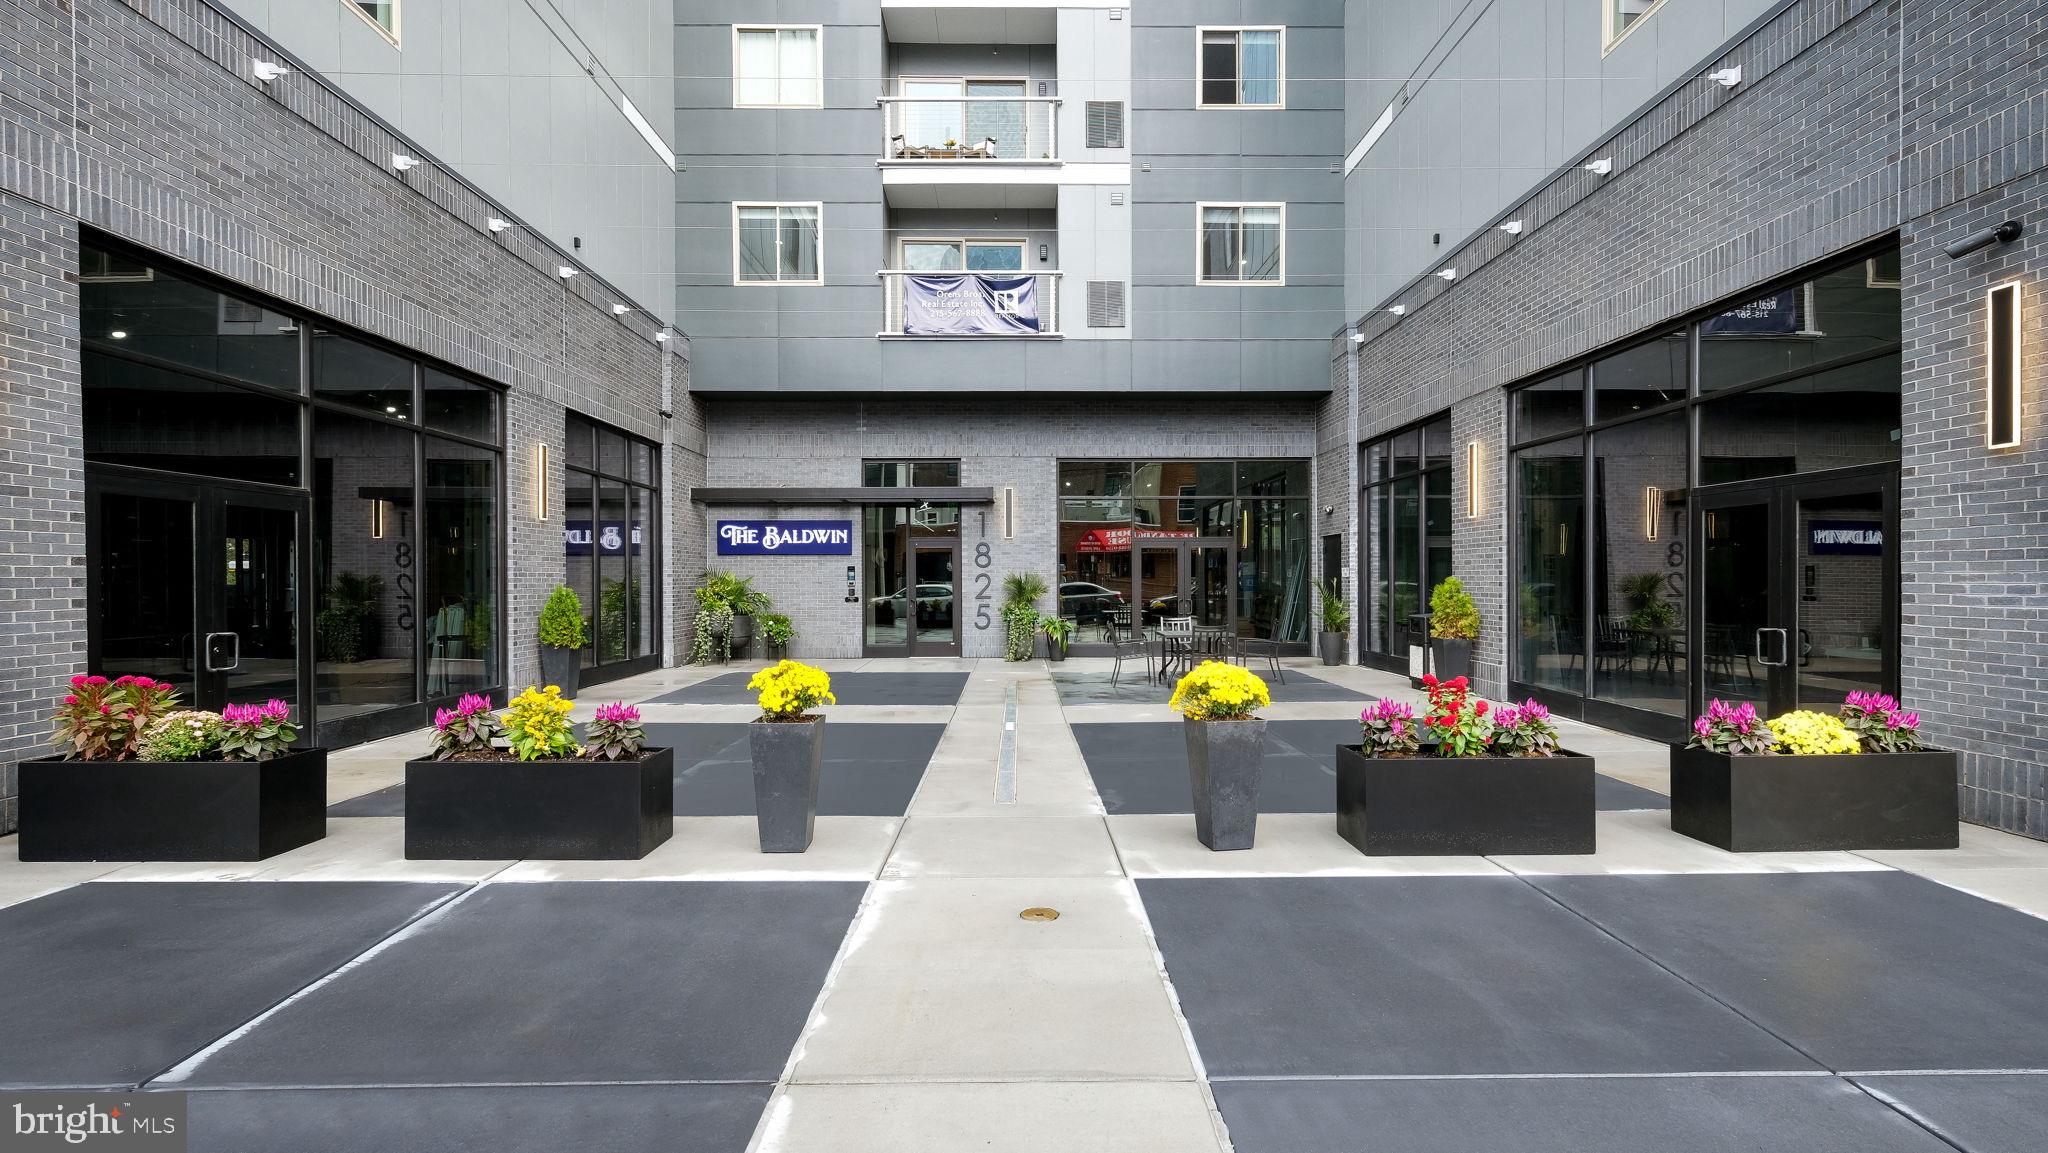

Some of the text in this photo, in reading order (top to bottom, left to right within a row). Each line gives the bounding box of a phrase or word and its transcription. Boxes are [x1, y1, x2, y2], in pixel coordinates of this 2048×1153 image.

[921, 299, 939, 308] Real
[941, 299, 968, 308] Estate
[720, 525, 848, 550] THE BALDWIN
[974, 511, 992, 631] 1825
